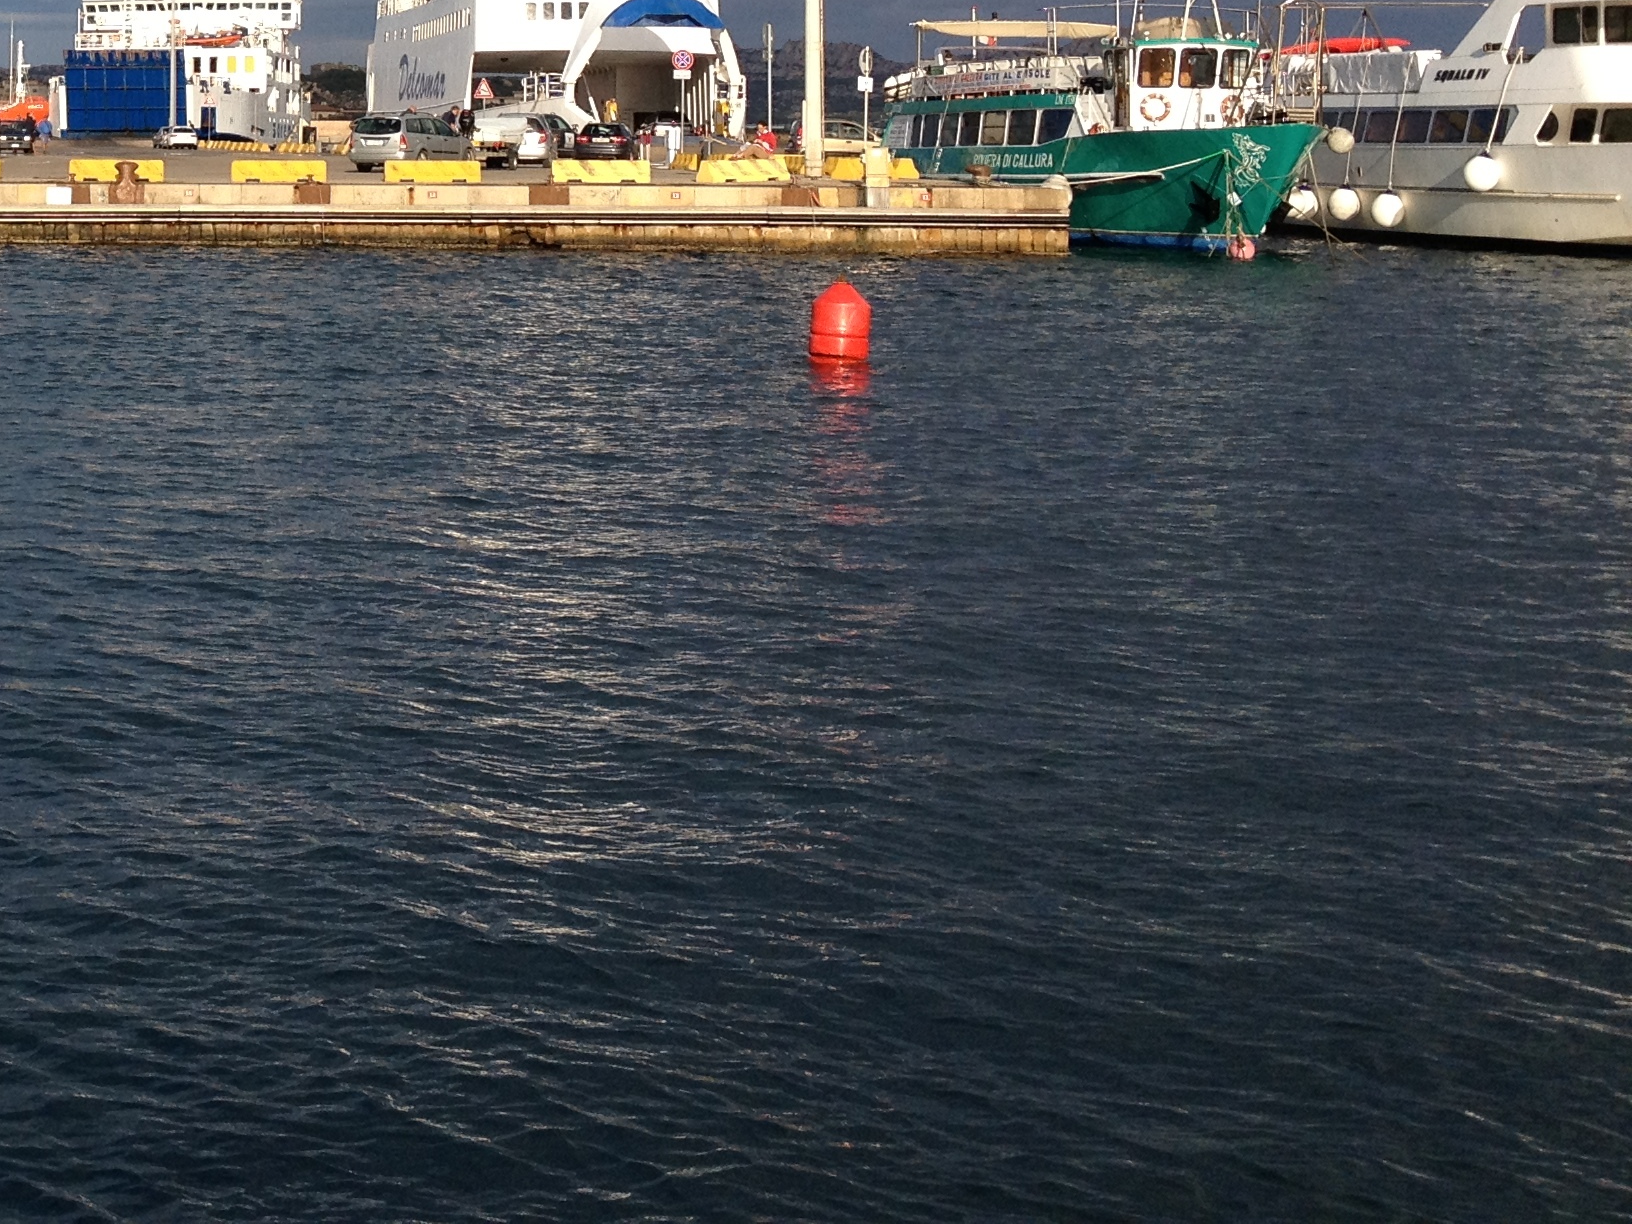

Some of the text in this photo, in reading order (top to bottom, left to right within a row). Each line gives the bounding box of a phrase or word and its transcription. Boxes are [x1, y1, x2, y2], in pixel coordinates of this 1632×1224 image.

[399, 54, 446, 101] Delcomar
[1434, 68, 1490, 83] SQUALO IV
[973, 153, 1002, 168] RIVIERA
[1002, 153, 1012, 167] DI
